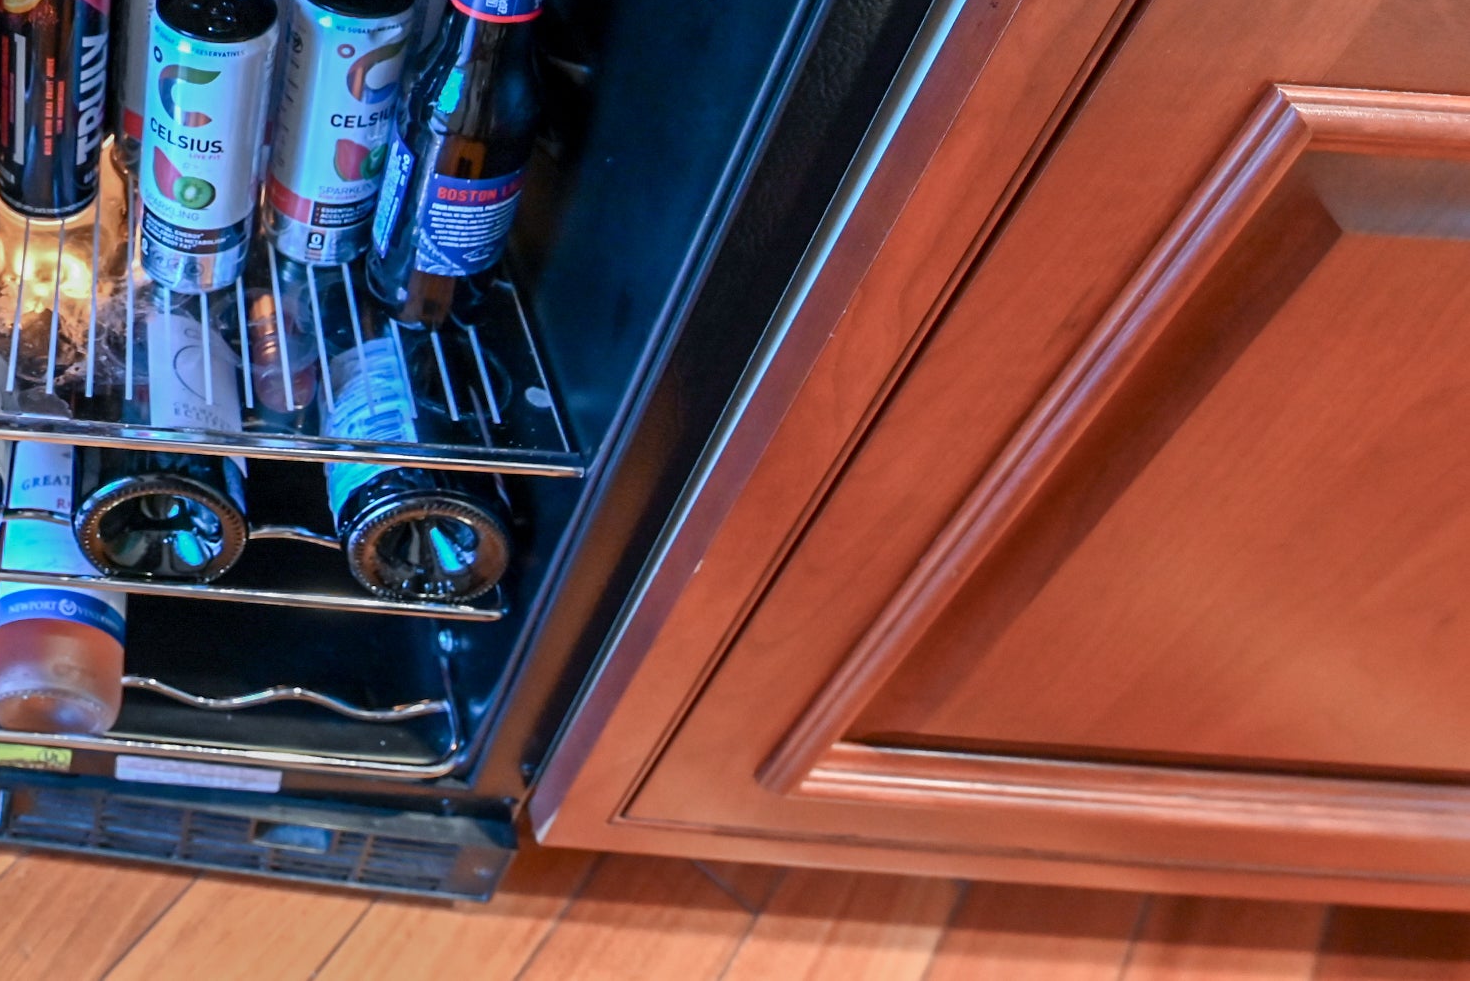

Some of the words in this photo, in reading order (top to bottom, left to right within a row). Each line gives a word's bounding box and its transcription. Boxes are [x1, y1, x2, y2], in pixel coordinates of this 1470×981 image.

[76, 34, 108, 165] TRULY
[150, 117, 222, 153] CELSIUS
[438, 187, 498, 202] BOSTON
[21, 474, 70, 490] GREAT
[8, 601, 56, 614] NEWPORT
